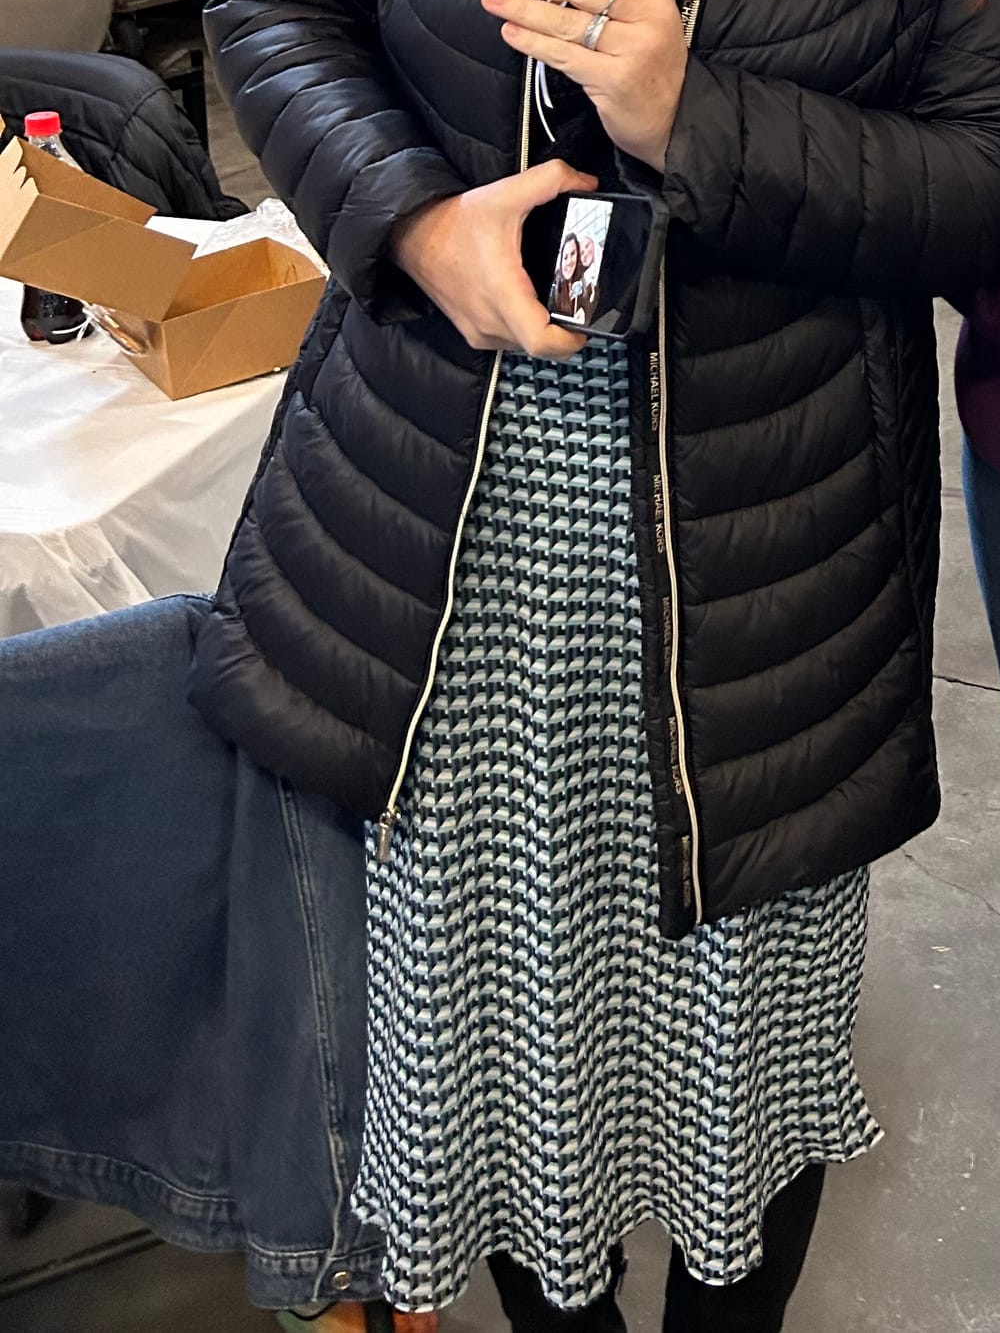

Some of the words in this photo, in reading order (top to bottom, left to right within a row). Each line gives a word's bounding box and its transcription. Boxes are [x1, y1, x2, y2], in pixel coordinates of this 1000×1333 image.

[649, 352, 660, 401] MICHAEL
[650, 401, 660, 432] KORS
[653, 474, 664, 522] MICHAEL
[655, 522, 666, 554] KORS
[662, 596, 672, 646] MICHAEL
[671, 765, 683, 795] KORS
